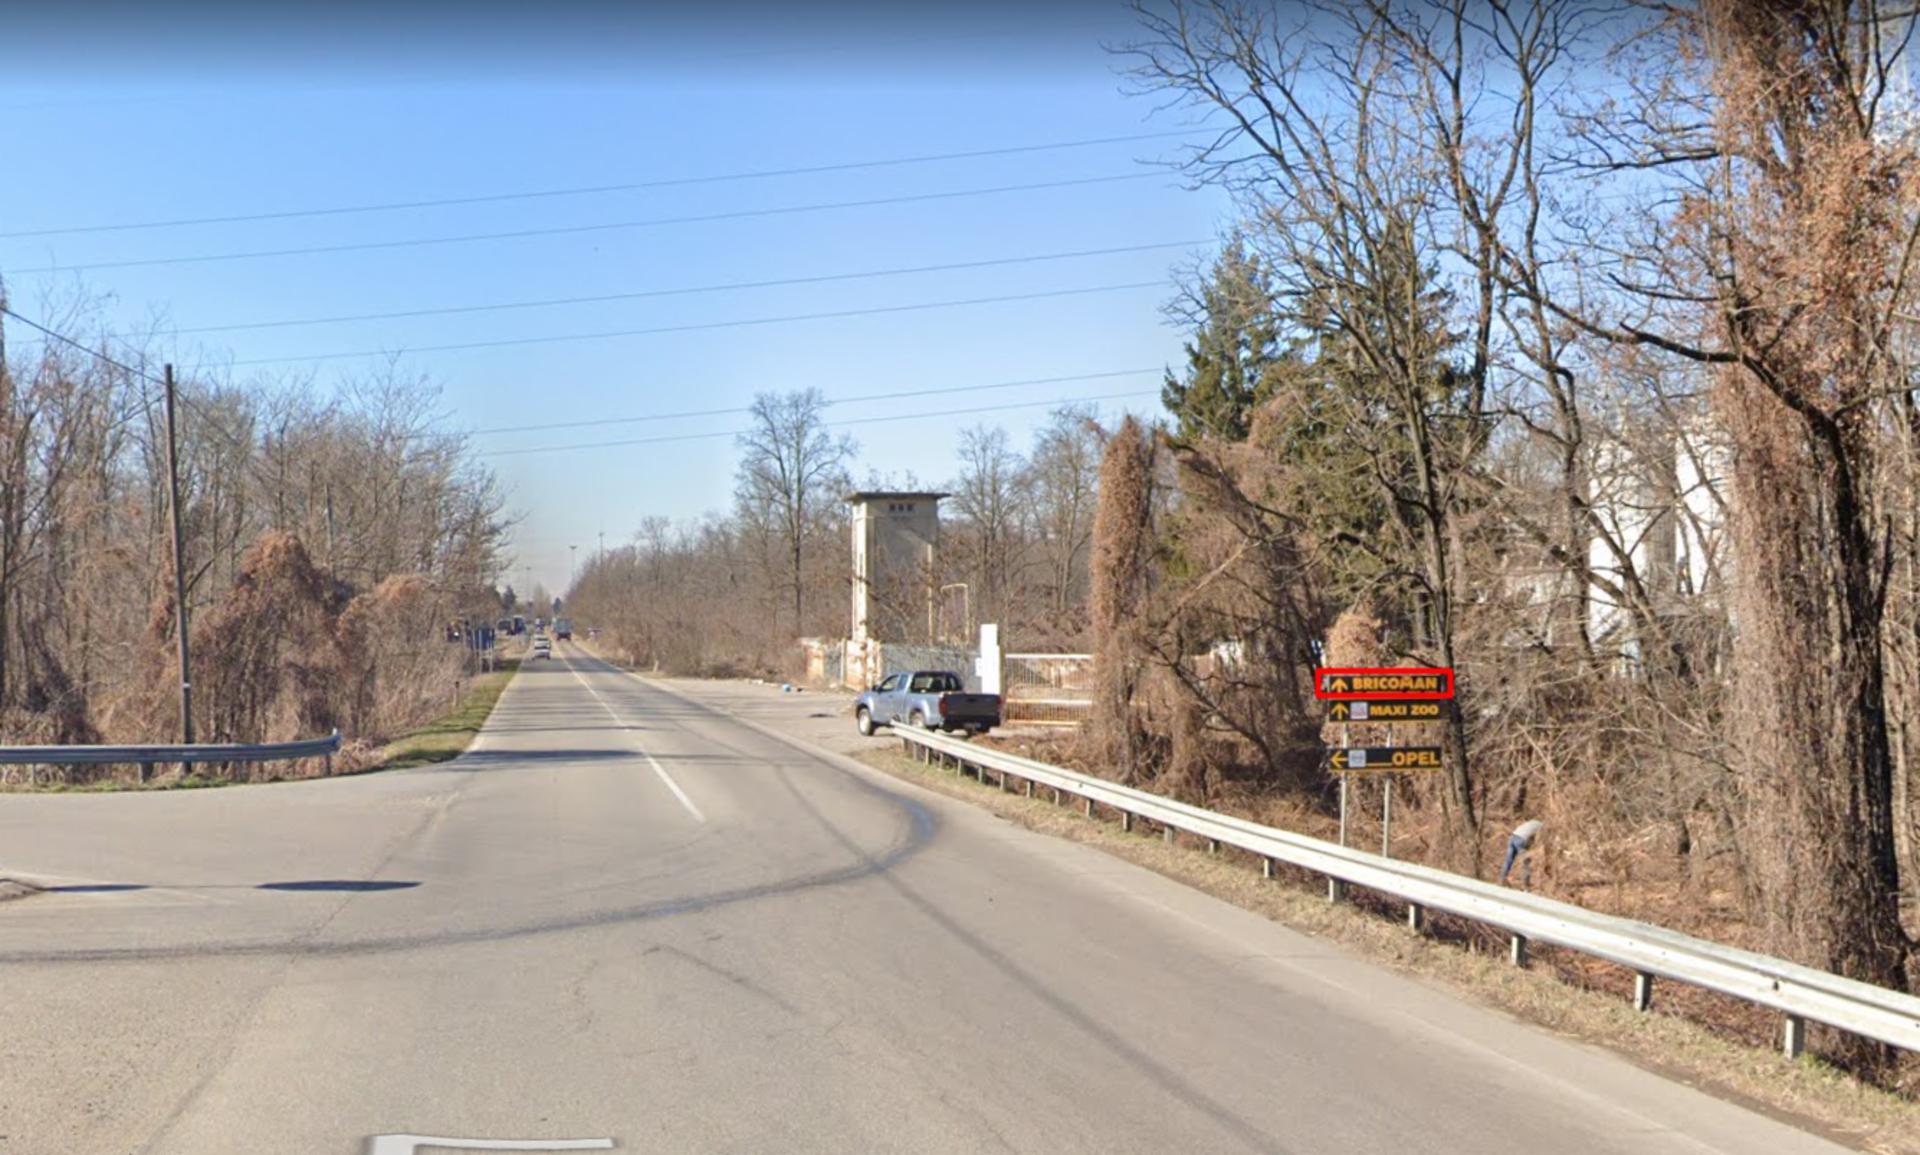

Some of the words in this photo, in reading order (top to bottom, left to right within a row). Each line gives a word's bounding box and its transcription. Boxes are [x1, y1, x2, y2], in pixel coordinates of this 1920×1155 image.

[1352, 677, 1437, 690] BRICOMAN
[1370, 705, 1407, 716] MAXI
[1411, 705, 1439, 716] ZOO
[1392, 752, 1440, 766] OPEL
